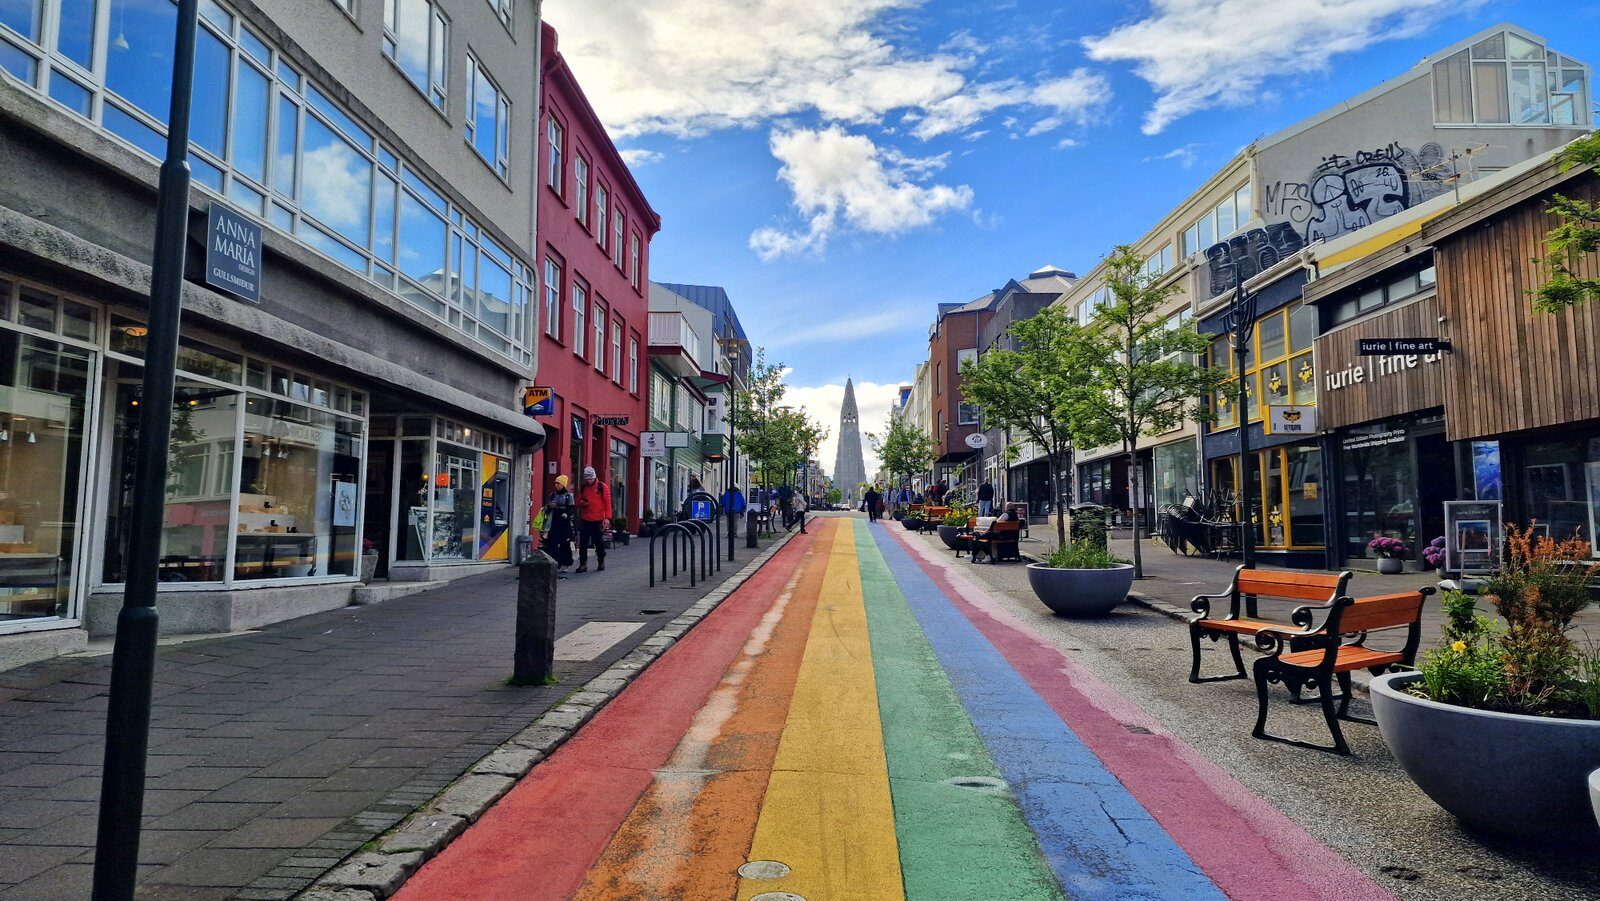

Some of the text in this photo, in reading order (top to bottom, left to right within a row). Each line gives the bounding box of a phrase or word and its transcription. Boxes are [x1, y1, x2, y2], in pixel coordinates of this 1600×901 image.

[216, 215, 255, 248] ANNA
[214, 234, 254, 269] MARÍA
[1362, 342, 1387, 351] iurie
[1395, 341, 1416, 350] fine
[1418, 341, 1434, 350] art
[1326, 362, 1364, 391] iurie
